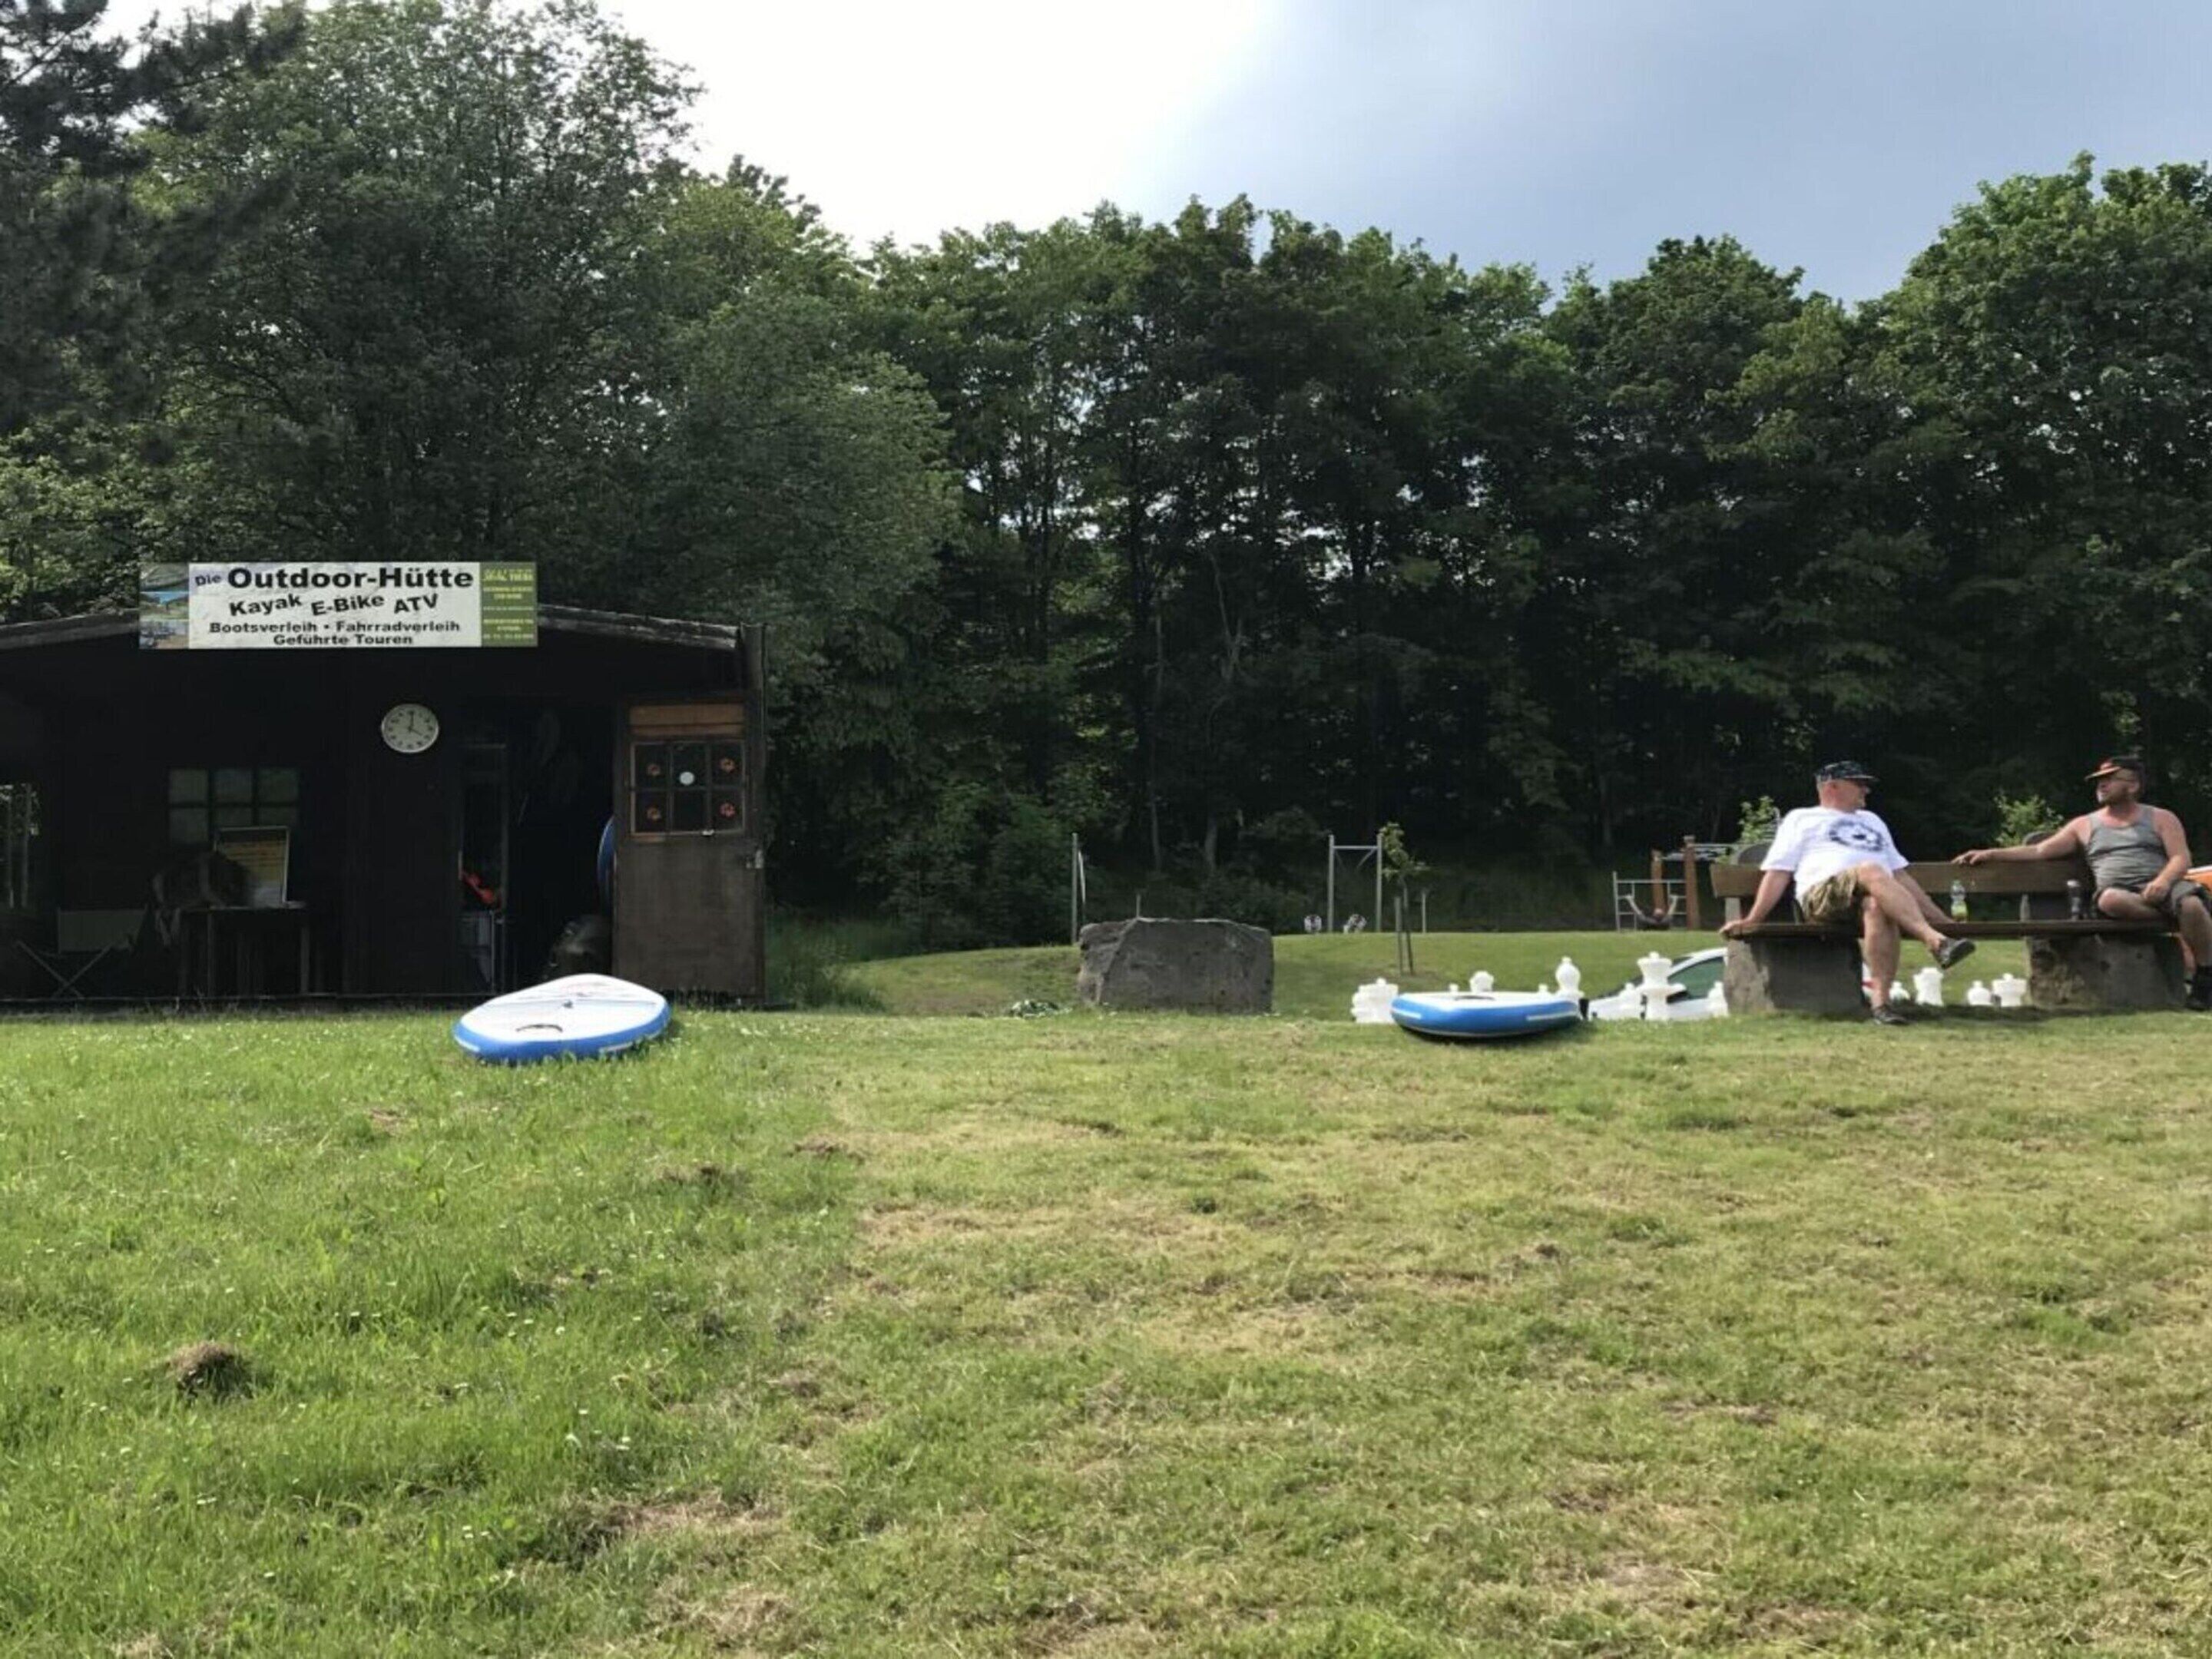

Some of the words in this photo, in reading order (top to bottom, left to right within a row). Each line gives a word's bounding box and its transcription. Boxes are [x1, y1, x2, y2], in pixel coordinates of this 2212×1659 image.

[195, 575, 222, 586] Die
[228, 568, 473, 588] Outdoor-Hütte
[229, 593, 302, 616] Kayak
[311, 594, 384, 616] E-Bike
[394, 592, 438, 614] ATV
[209, 621, 317, 633] Bootsverleih
[336, 621, 460, 634] Fahrradverleih
[273, 634, 349, 645] Geführte
[355, 634, 413, 644] Touren
